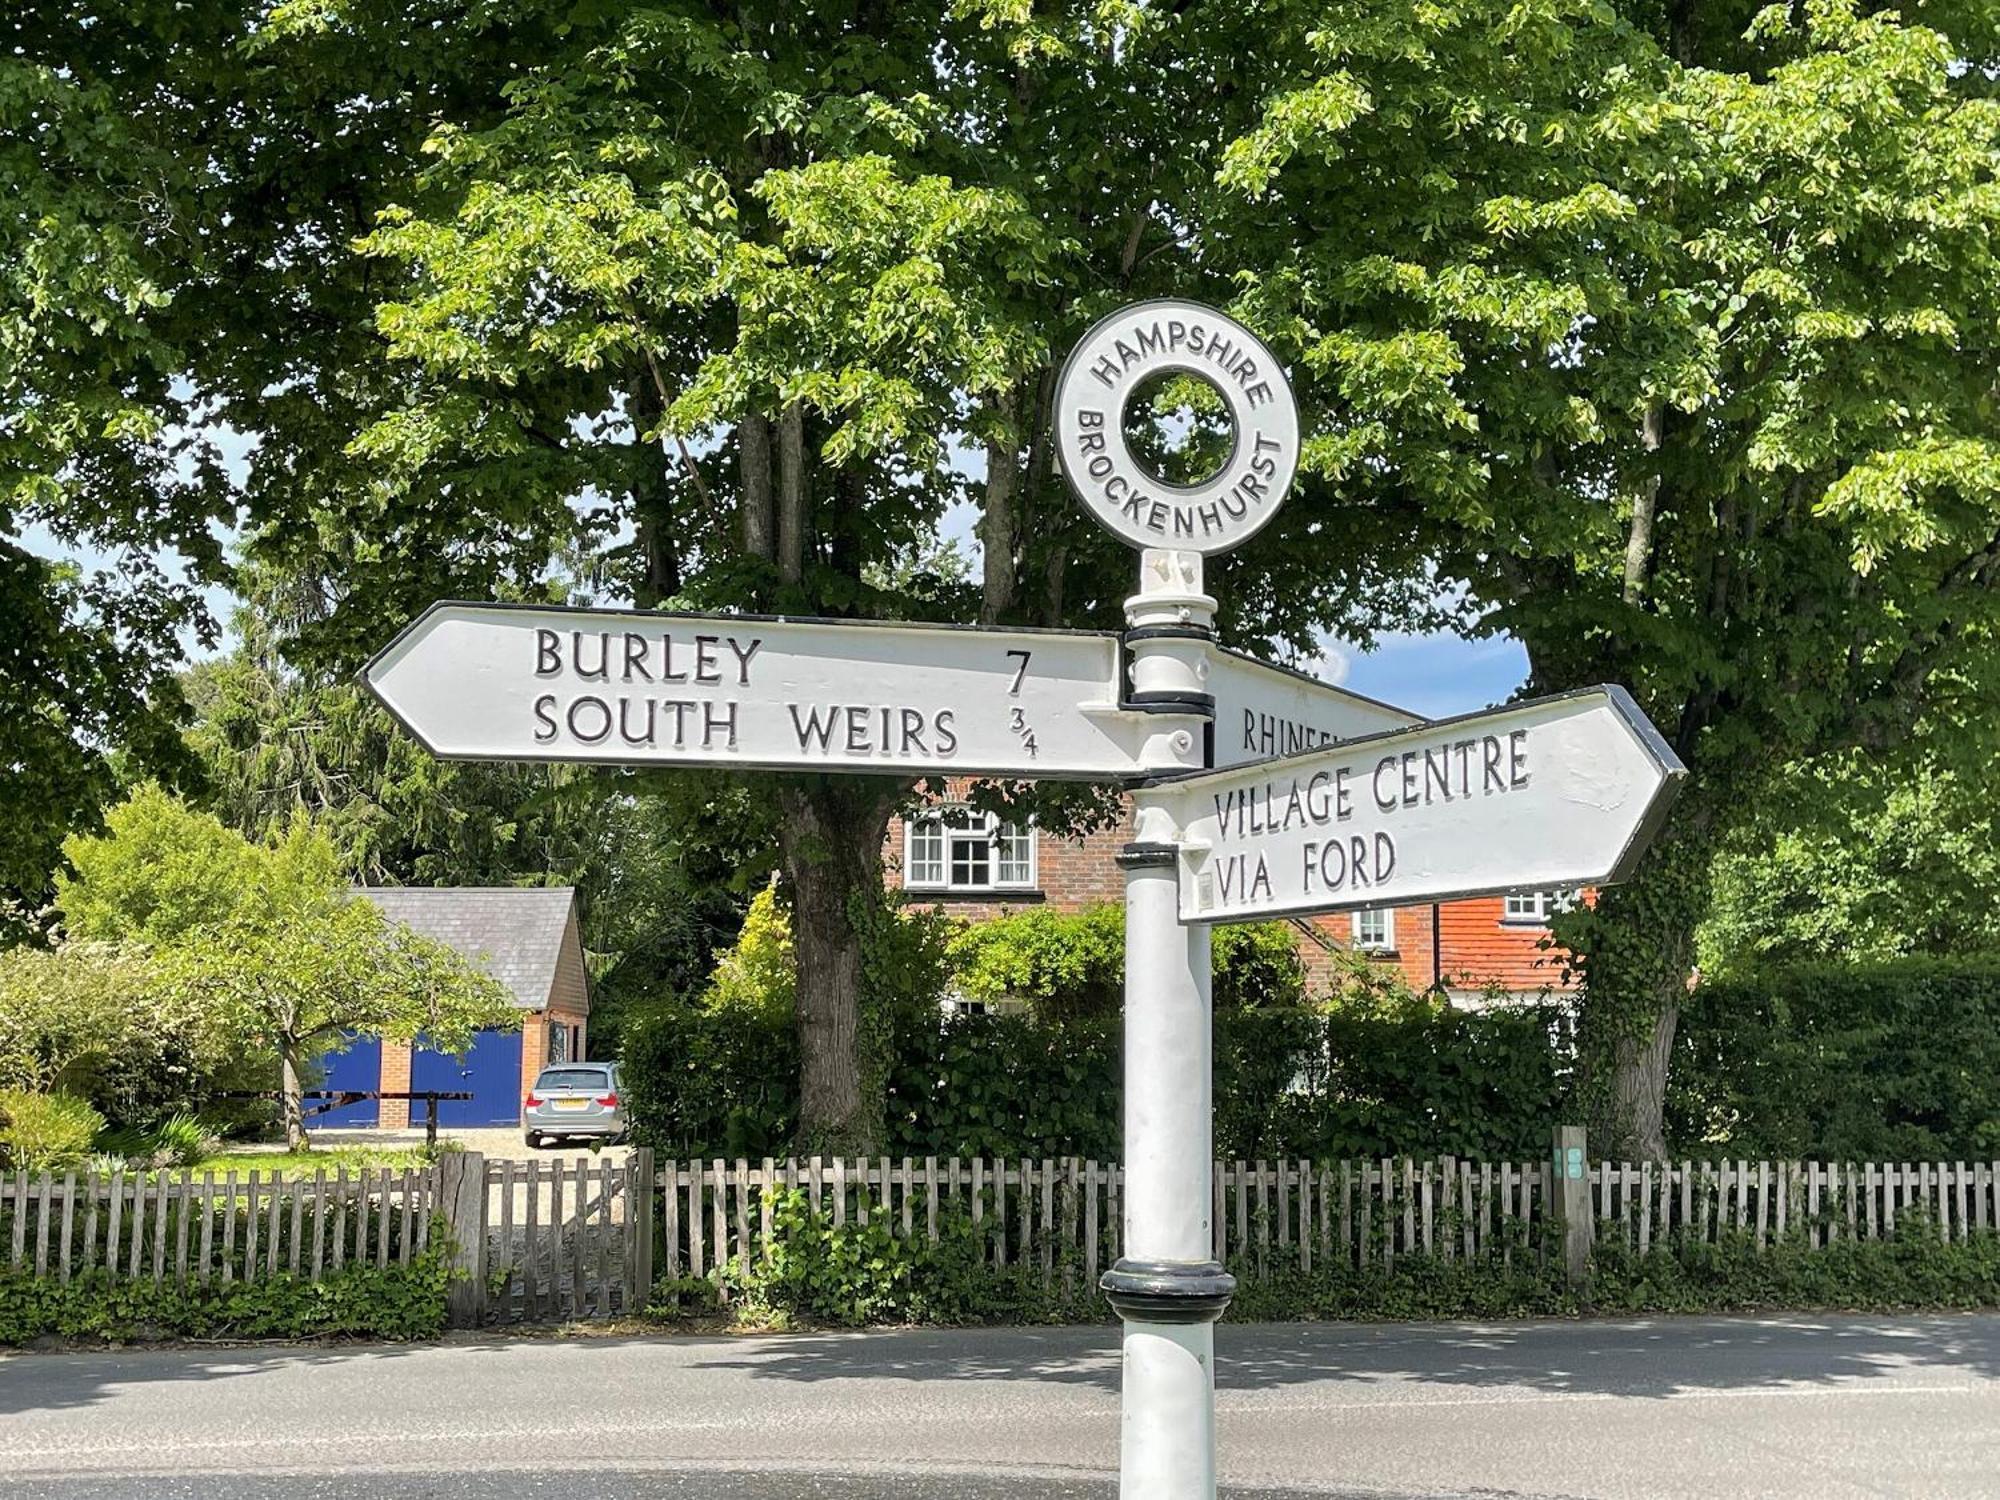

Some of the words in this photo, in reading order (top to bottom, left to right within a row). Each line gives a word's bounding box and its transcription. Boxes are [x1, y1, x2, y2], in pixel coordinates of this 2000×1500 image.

[1089, 320, 1276, 411] HAMPSHIRE
[1077, 408, 1282, 536] BROCKENHURST
[535, 628, 762, 685] BURLEY
[1006, 649, 1032, 694] 7
[533, 694, 740, 748] SOUTH
[787, 703, 959, 756] WEIRS
[1213, 766, 1352, 842] VILLAGE
[1372, 728, 1530, 811] CENTRE
[1215, 851, 1274, 905] VIA
[1302, 830, 1397, 893] FORD
